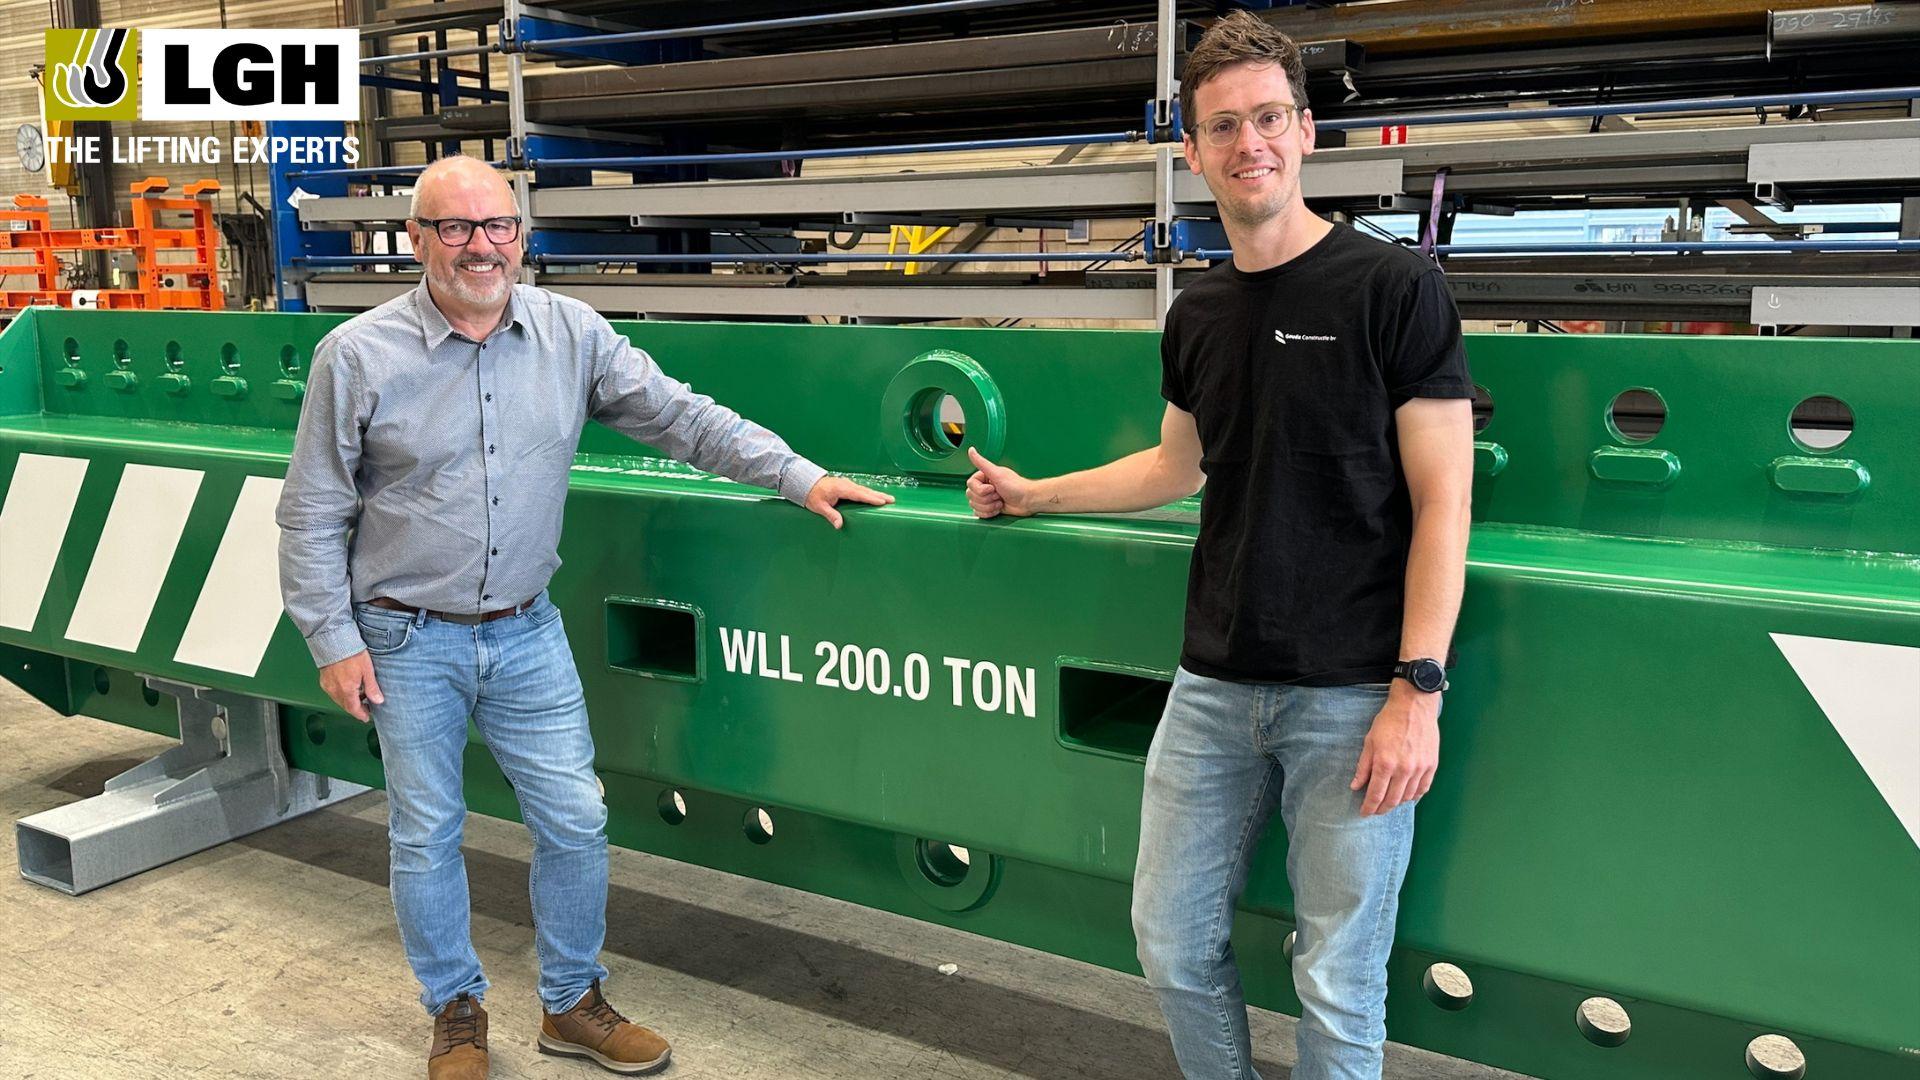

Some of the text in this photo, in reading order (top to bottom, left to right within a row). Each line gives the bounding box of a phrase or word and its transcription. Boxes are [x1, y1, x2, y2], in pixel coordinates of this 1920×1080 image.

[719, 626, 1036, 718] WLL 200.0 TON
